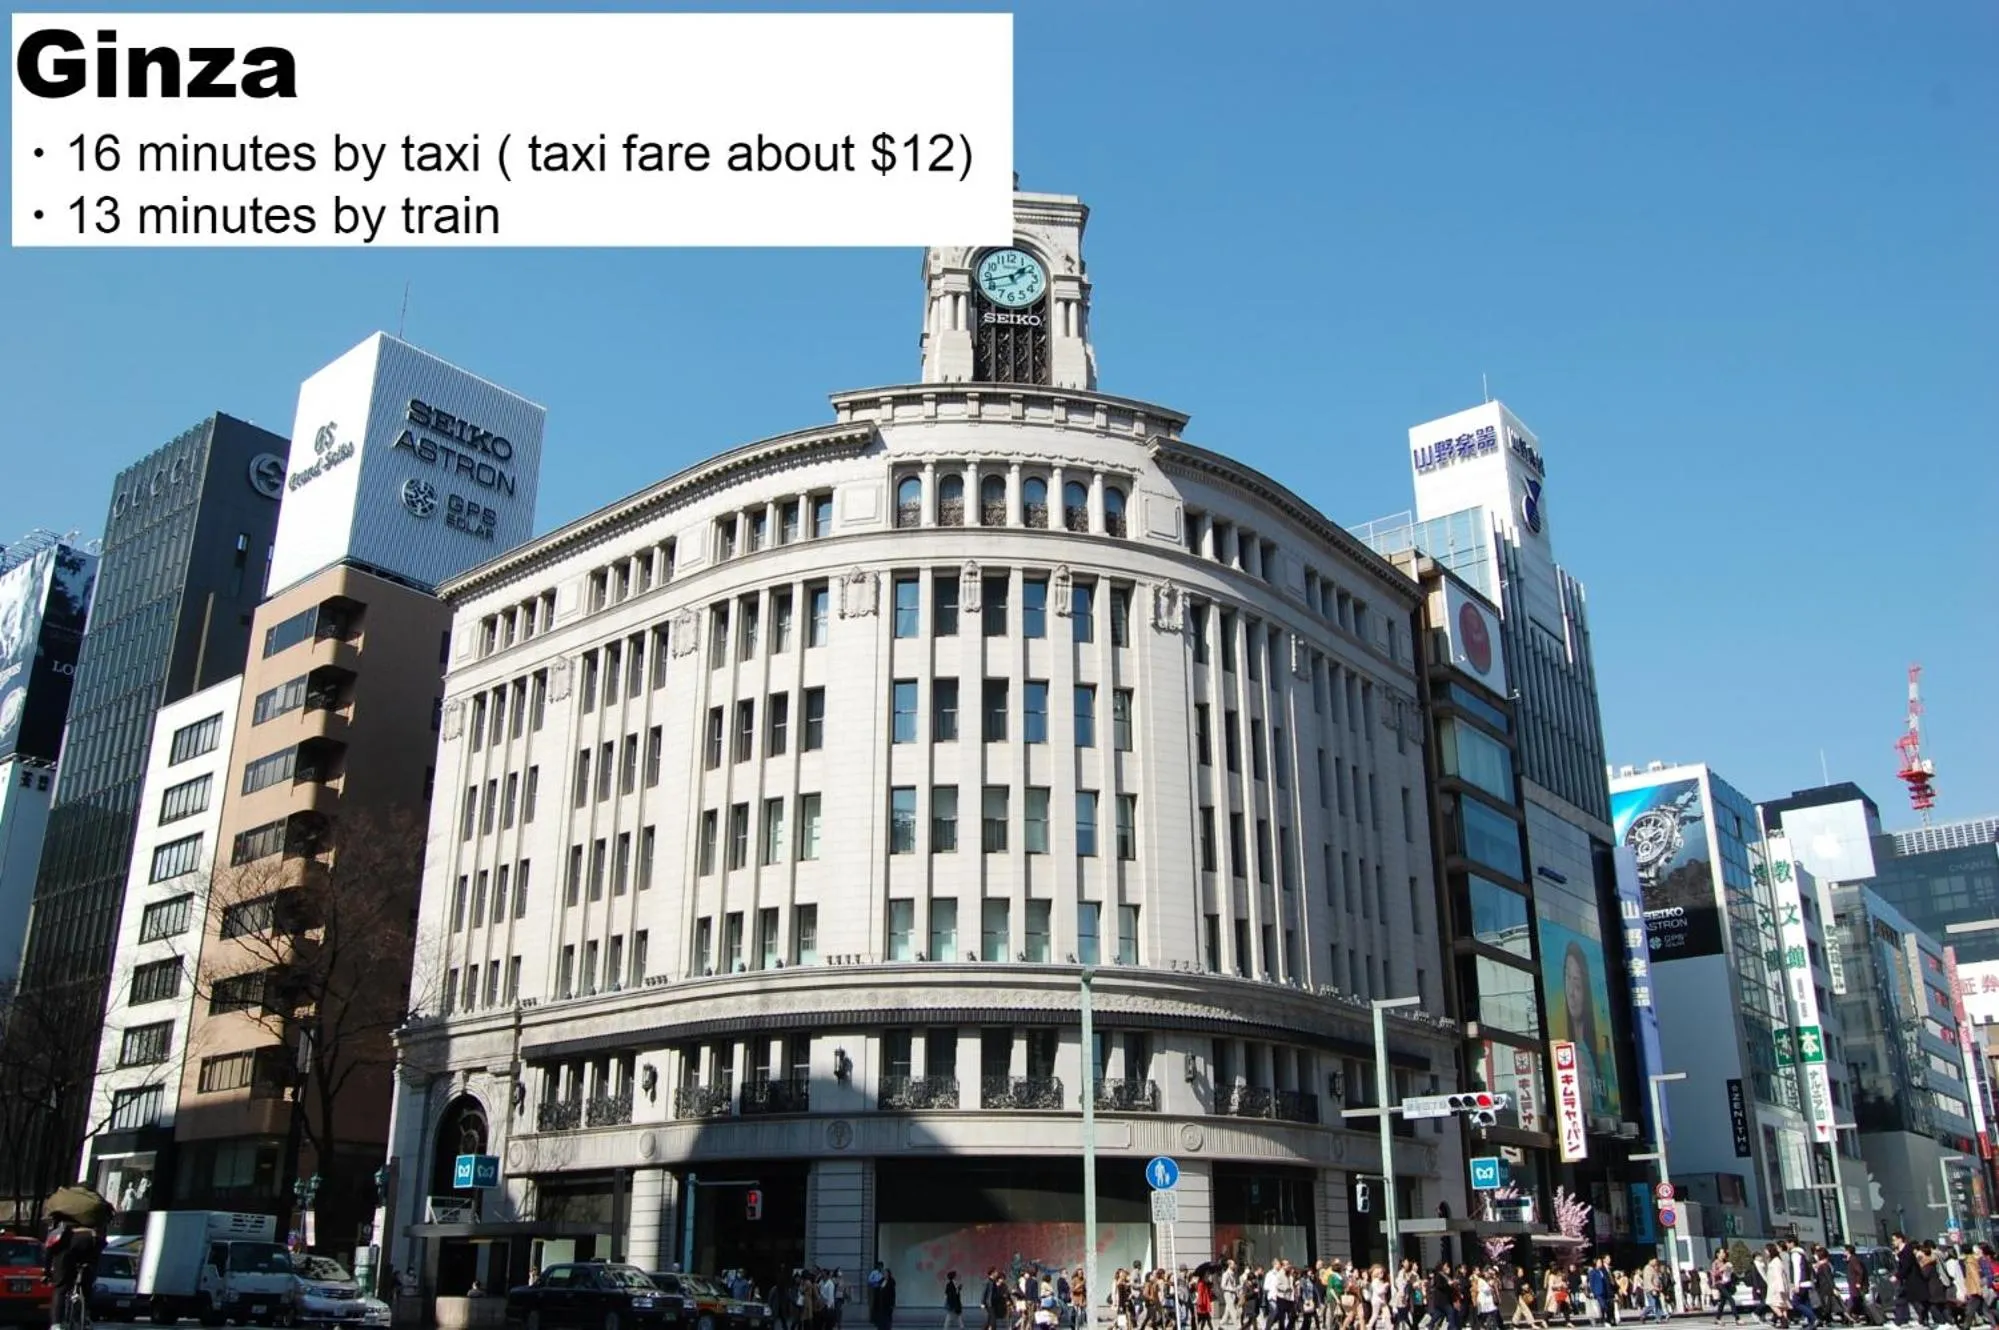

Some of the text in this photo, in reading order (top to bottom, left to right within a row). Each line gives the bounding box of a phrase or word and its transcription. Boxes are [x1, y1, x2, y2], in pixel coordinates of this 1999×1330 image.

[988, 262, 997, 271] 10
[1007, 254, 1017, 264] 12
[1031, 274, 1039, 284] 3
[998, 289, 1005, 298] 7
[1007, 292, 1015, 302] 6
[1018, 290, 1026, 300] 5
[1026, 284, 1034, 293] 4
[983, 312, 1041, 326] SEIKO
[406, 399, 513, 462] SEIKO
[1413, 425, 1497, 471] 山野楽器
[288, 441, 355, 492] Grand Seiko
[393, 429, 516, 497] ASTRON
[448, 494, 497, 526] GPS
[447, 513, 494, 541] SOLAR
[52, 659, 76, 676] LO
[1642, 906, 1684, 920] SEIKO
[1773, 859, 1807, 969] 教文館
[1560, 1073, 1581, 1152] キムラヤのパン
[1732, 1093, 1747, 1143] ZENITH
